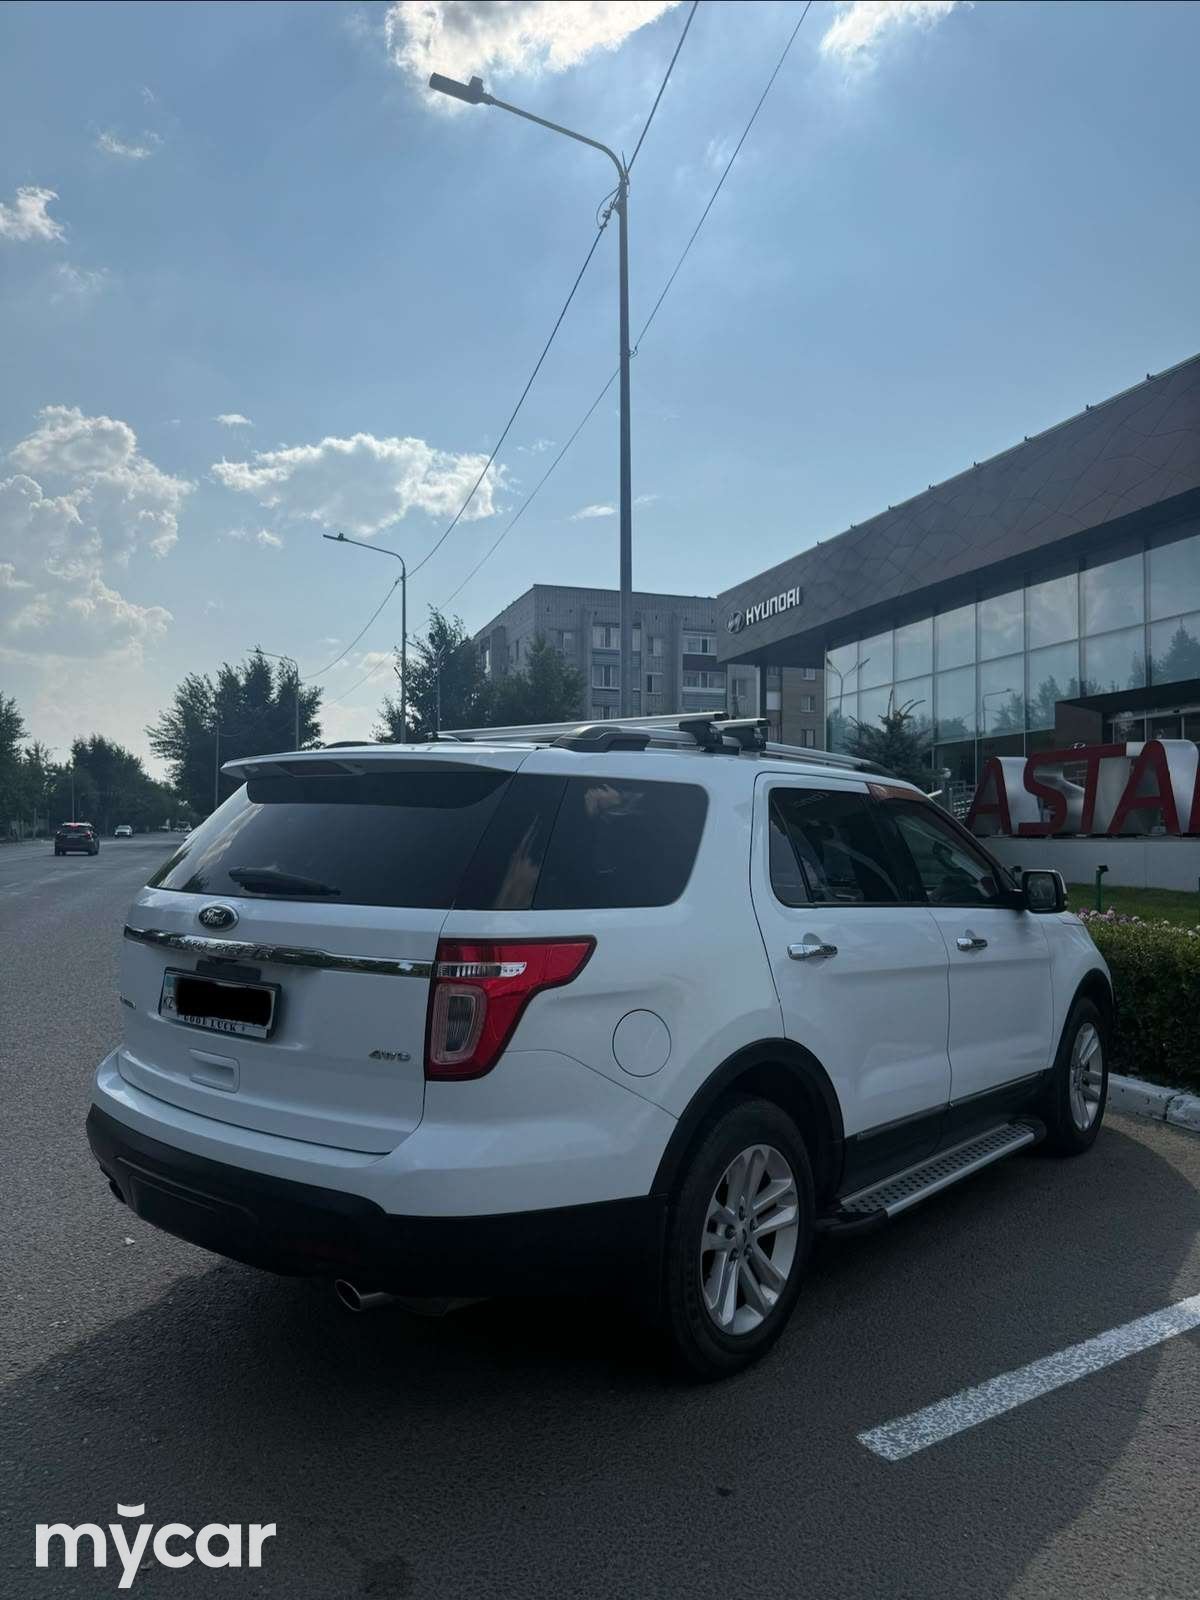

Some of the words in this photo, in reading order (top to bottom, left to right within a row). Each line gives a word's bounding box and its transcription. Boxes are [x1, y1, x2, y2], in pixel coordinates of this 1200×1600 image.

[746, 586, 800, 625] HYUNDAI
[967, 740, 1200, 836] ASTA
[368, 1050, 411, 1062] 4WD
